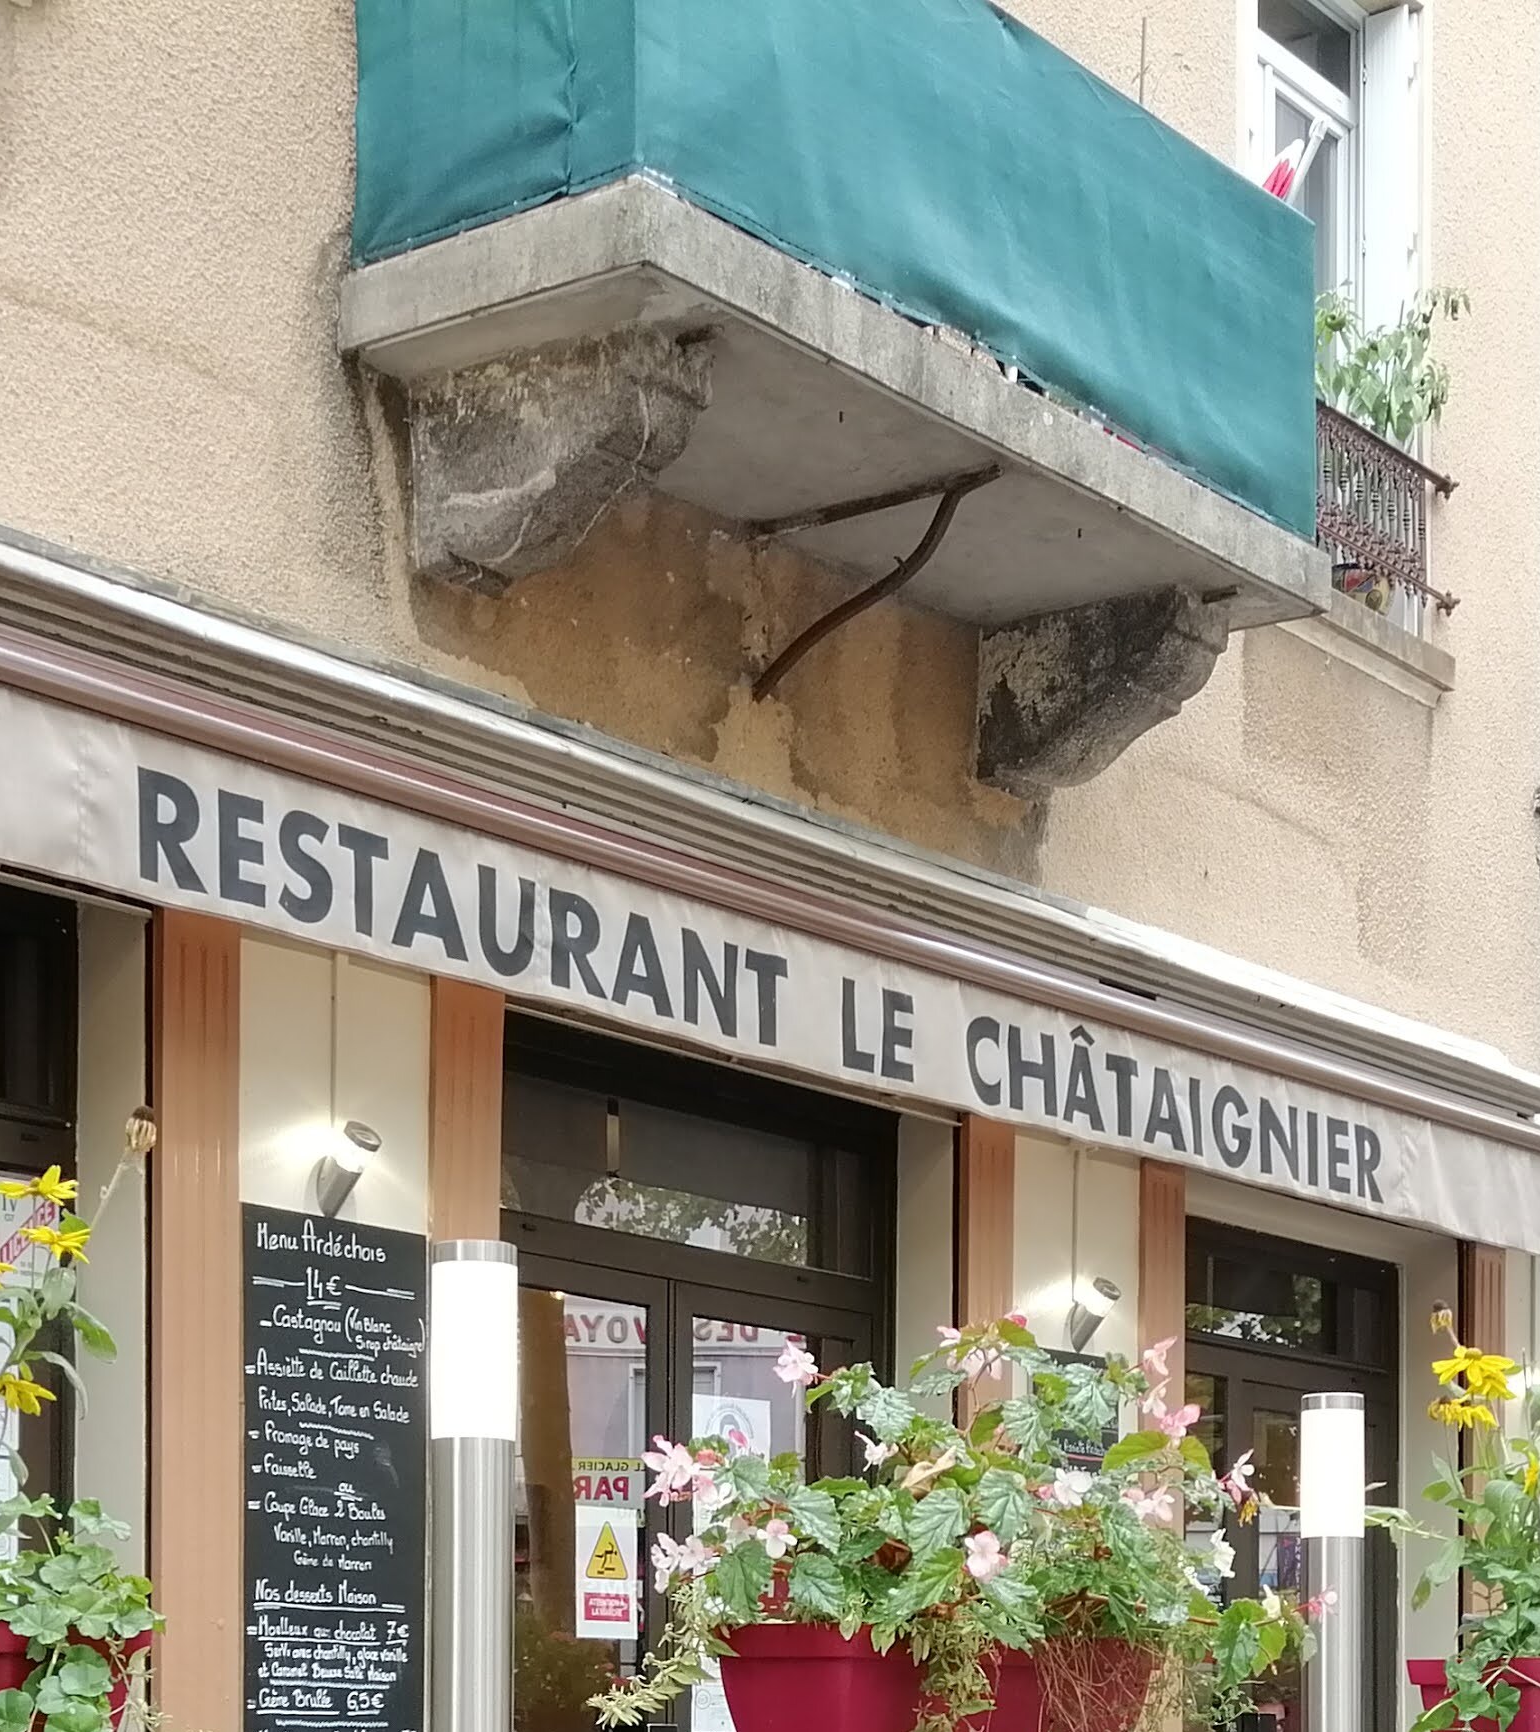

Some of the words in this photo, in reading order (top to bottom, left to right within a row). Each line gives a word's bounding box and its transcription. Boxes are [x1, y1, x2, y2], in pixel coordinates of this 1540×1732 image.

[136, 765, 789, 1047] RESTAURANT
[841, 976, 914, 1082] LE
[965, 1016, 1384, 1204] CHÂTAIGNIER
[257, 1222, 299, 1250] Menu
[301, 1219, 386, 1262] Ardéchois
[272, 1304, 341, 1344] Castagnou
[309, 1361, 324, 1380] de
[380, 1364, 419, 1387] chaude
[373, 1400, 411, 1424] Salade
[315, 1432, 330, 1449] de
[334, 1439, 360, 1459] pays
[264, 1491, 296, 1521] Coupe
[348, 1502, 386, 1521] Boules
[254, 1578, 280, 1601] Nos
[338, 1579, 377, 1605] Maison
